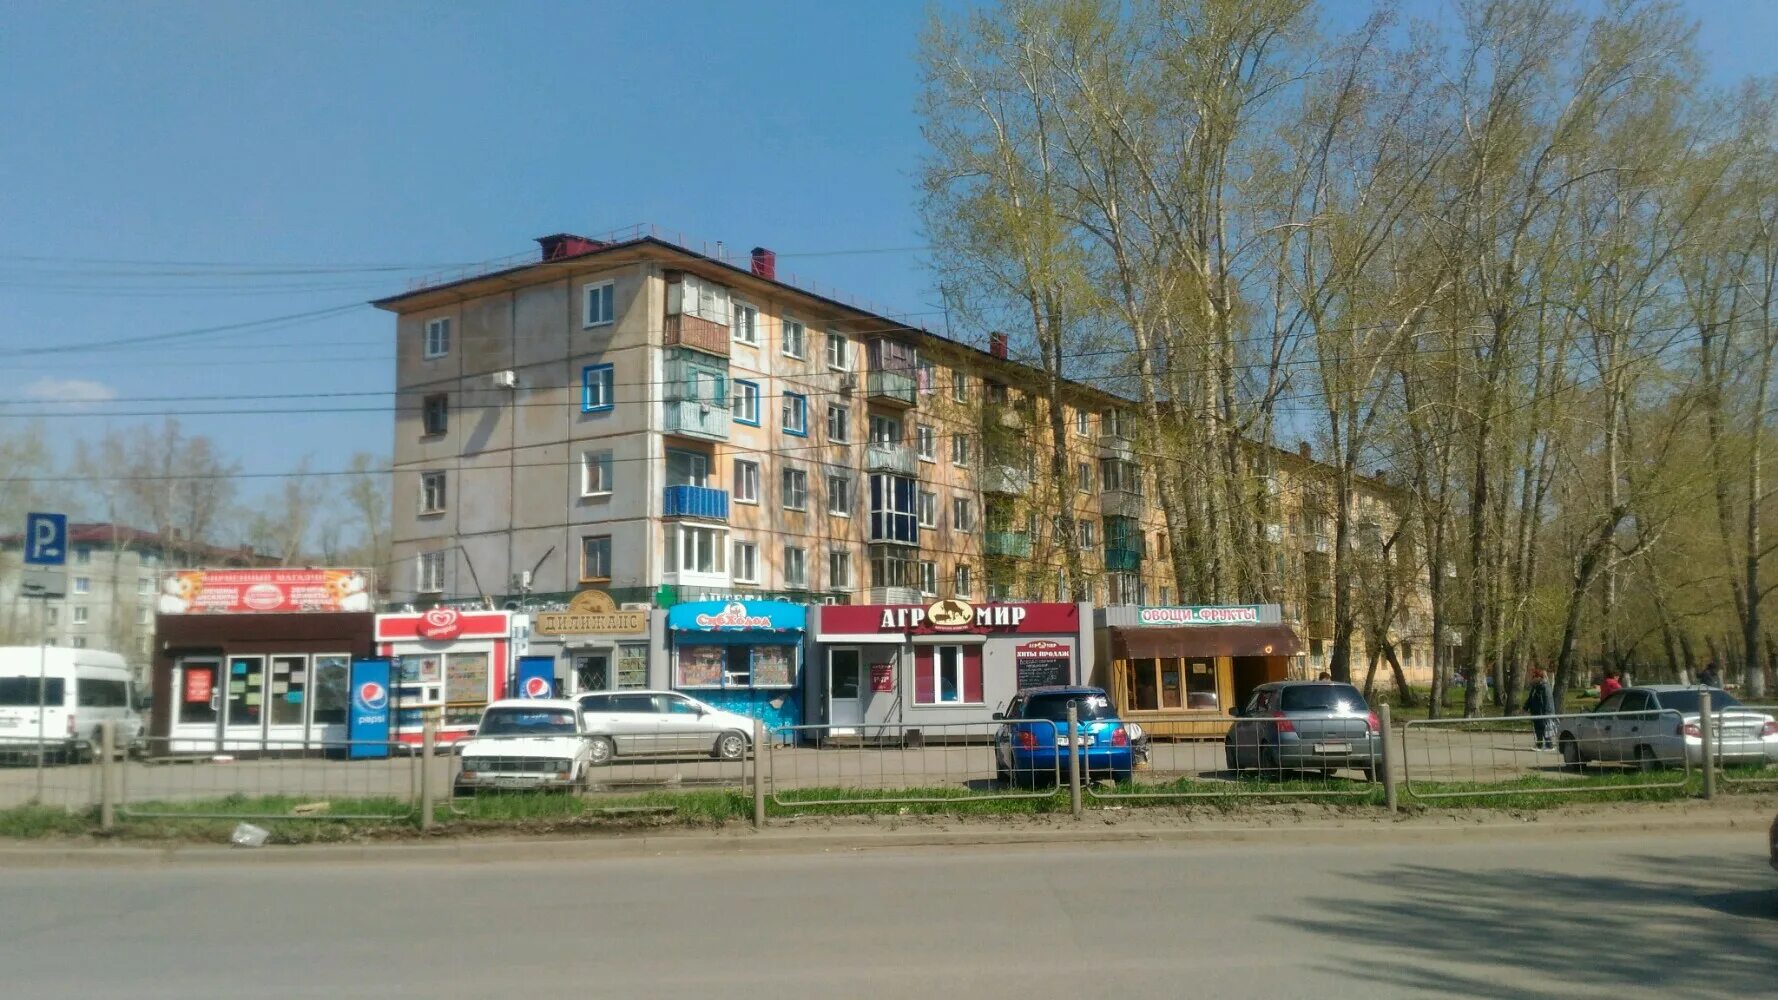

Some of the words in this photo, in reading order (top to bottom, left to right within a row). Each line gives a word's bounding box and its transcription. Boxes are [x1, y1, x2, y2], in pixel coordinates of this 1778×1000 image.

[33, 518, 56, 558] P
[976, 607, 1026, 626] МИР
[1143, 609, 1191, 621] ОВОЩИ
[1200, 608, 1256, 620] ФРУКТЫ
[545, 615, 638, 630] ДИЛИЖАНС
[359, 715, 385, 725] pepsi
